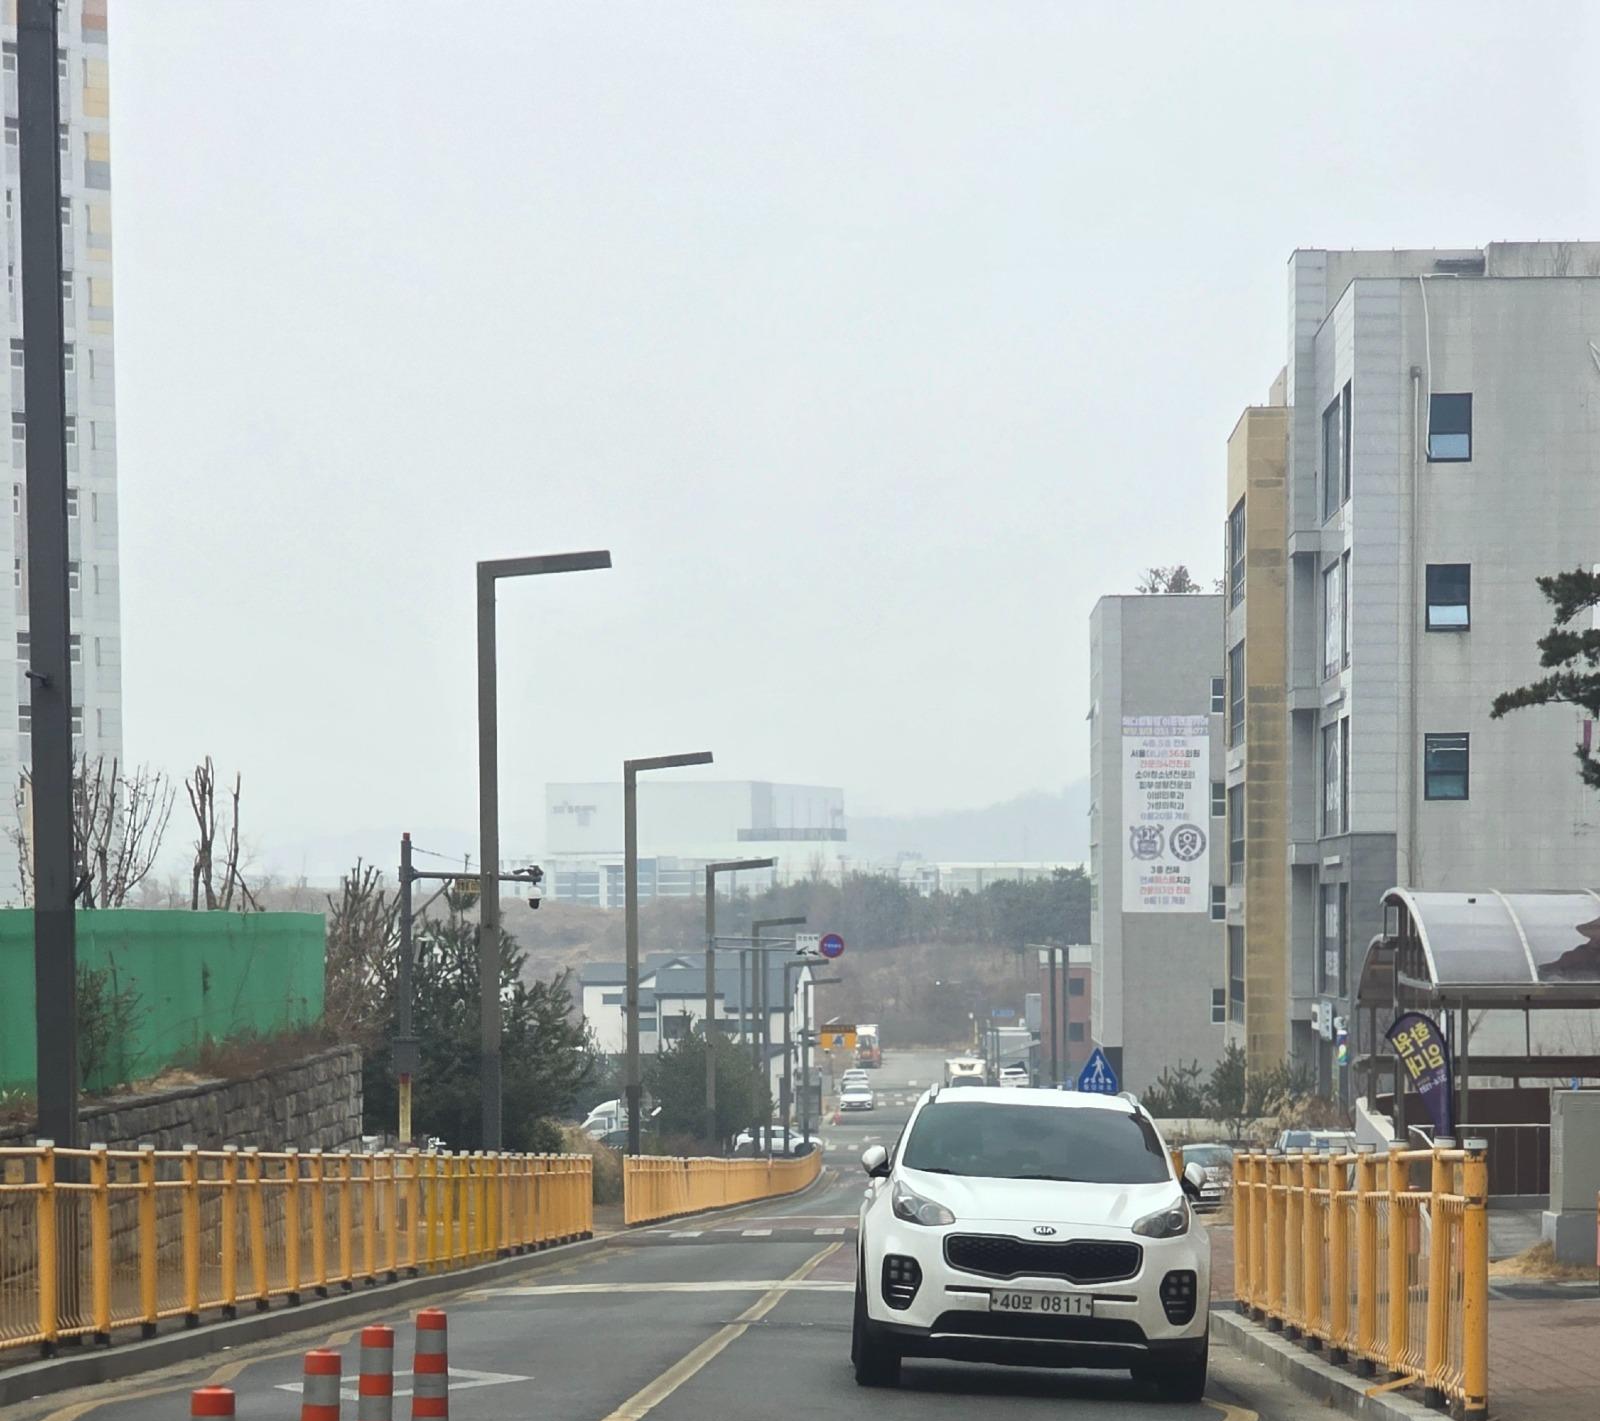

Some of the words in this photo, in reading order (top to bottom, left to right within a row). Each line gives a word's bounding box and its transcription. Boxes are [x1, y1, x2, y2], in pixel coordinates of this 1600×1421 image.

[1146, 791, 1185, 800] 이비인후과
[1034, 1226, 1056, 1235] KIA
[1041, 1296, 1081, 1313] 0811
